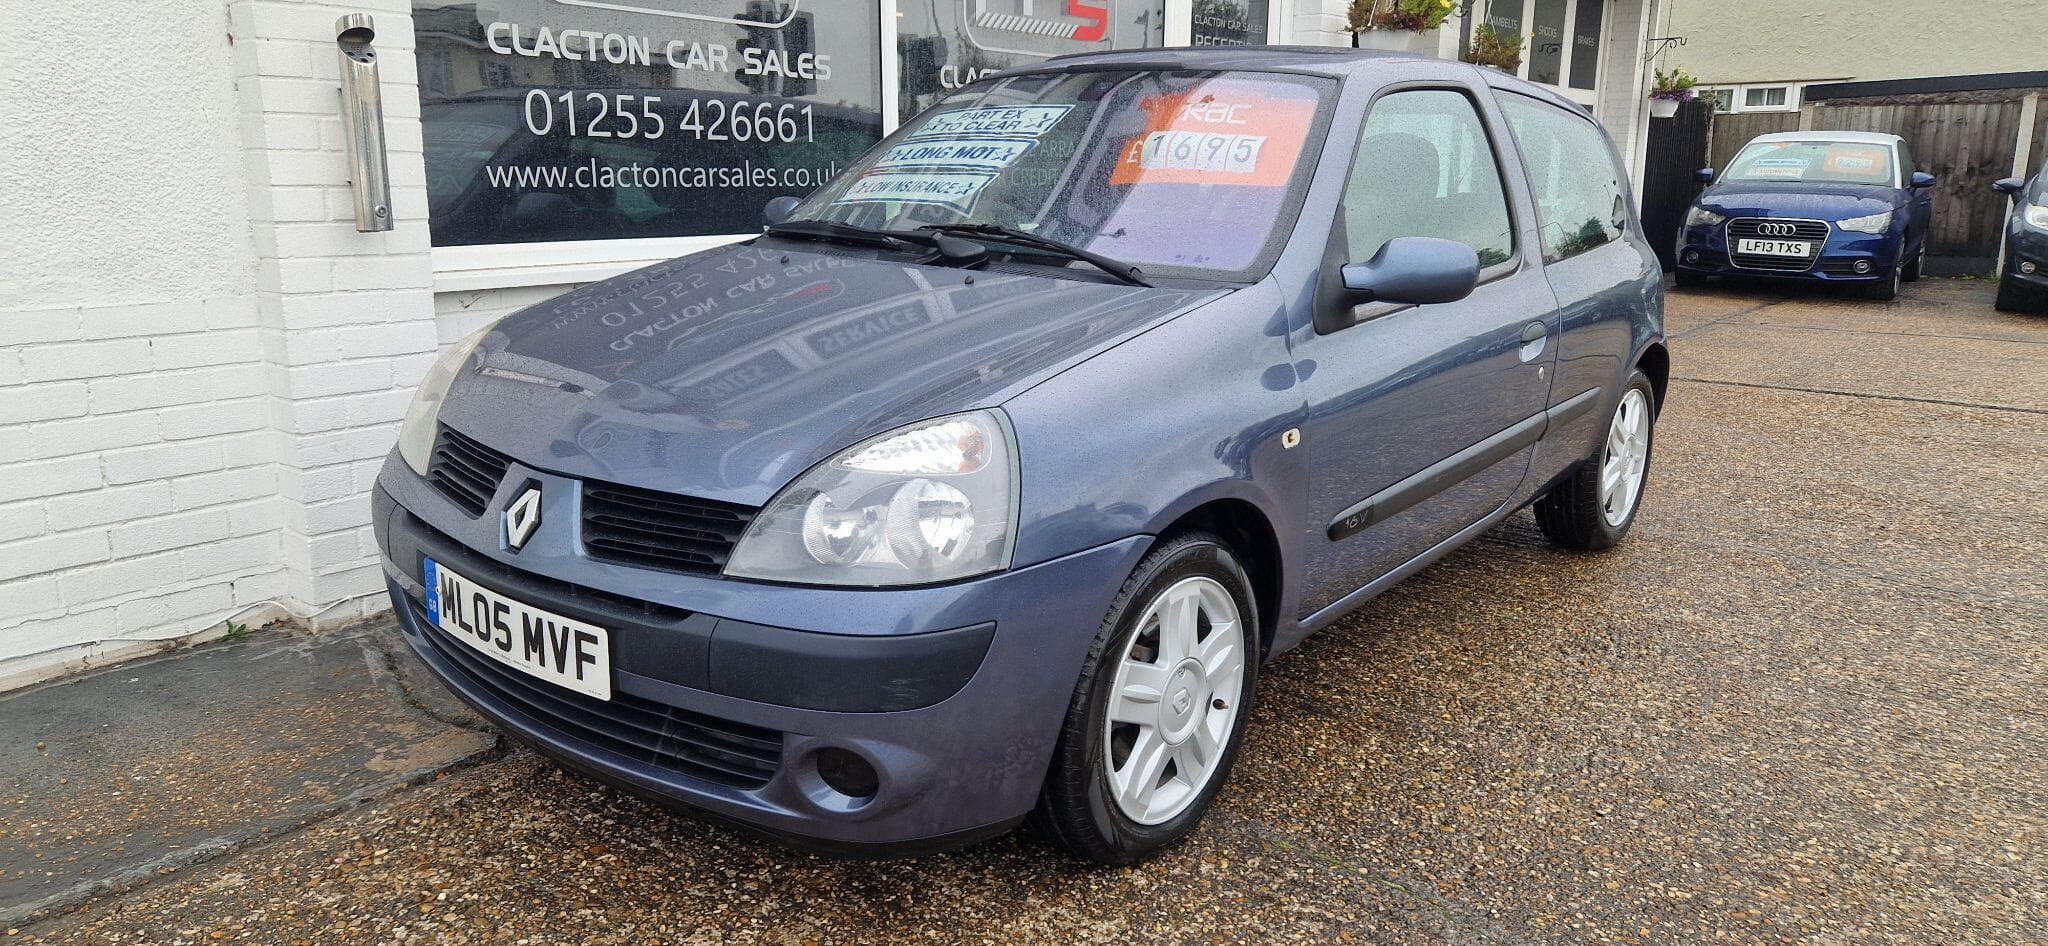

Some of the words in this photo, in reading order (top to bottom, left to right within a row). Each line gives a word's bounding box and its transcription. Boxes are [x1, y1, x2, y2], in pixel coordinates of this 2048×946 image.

[1194, 14, 1226, 28] CLACTON
[1227, 20, 1241, 31] CAR
[1242, 23, 1263, 33] SALES
[487, 21, 650, 67] CLACTON
[666, 40, 728, 73] CAR
[744, 48, 832, 81] SALES
[524, 88, 666, 141] 01255
[679, 98, 815, 143] 426661
[957, 111, 998, 121] PART
[1005, 108, 1029, 119] EX
[963, 120, 1022, 131] CLEAR
[901, 146, 950, 160] LONG
[952, 147, 996, 160] MOT
[486, 158, 842, 188] www.clactoncarsales.co.uk
[867, 182, 890, 193] LOW
[888, 181, 955, 194] INSURANCE
[1746, 240, 1774, 252] LF13
[1777, 242, 1802, 254] TXS
[440, 571, 512, 652] ML05
[521, 612, 599, 681] MVF
